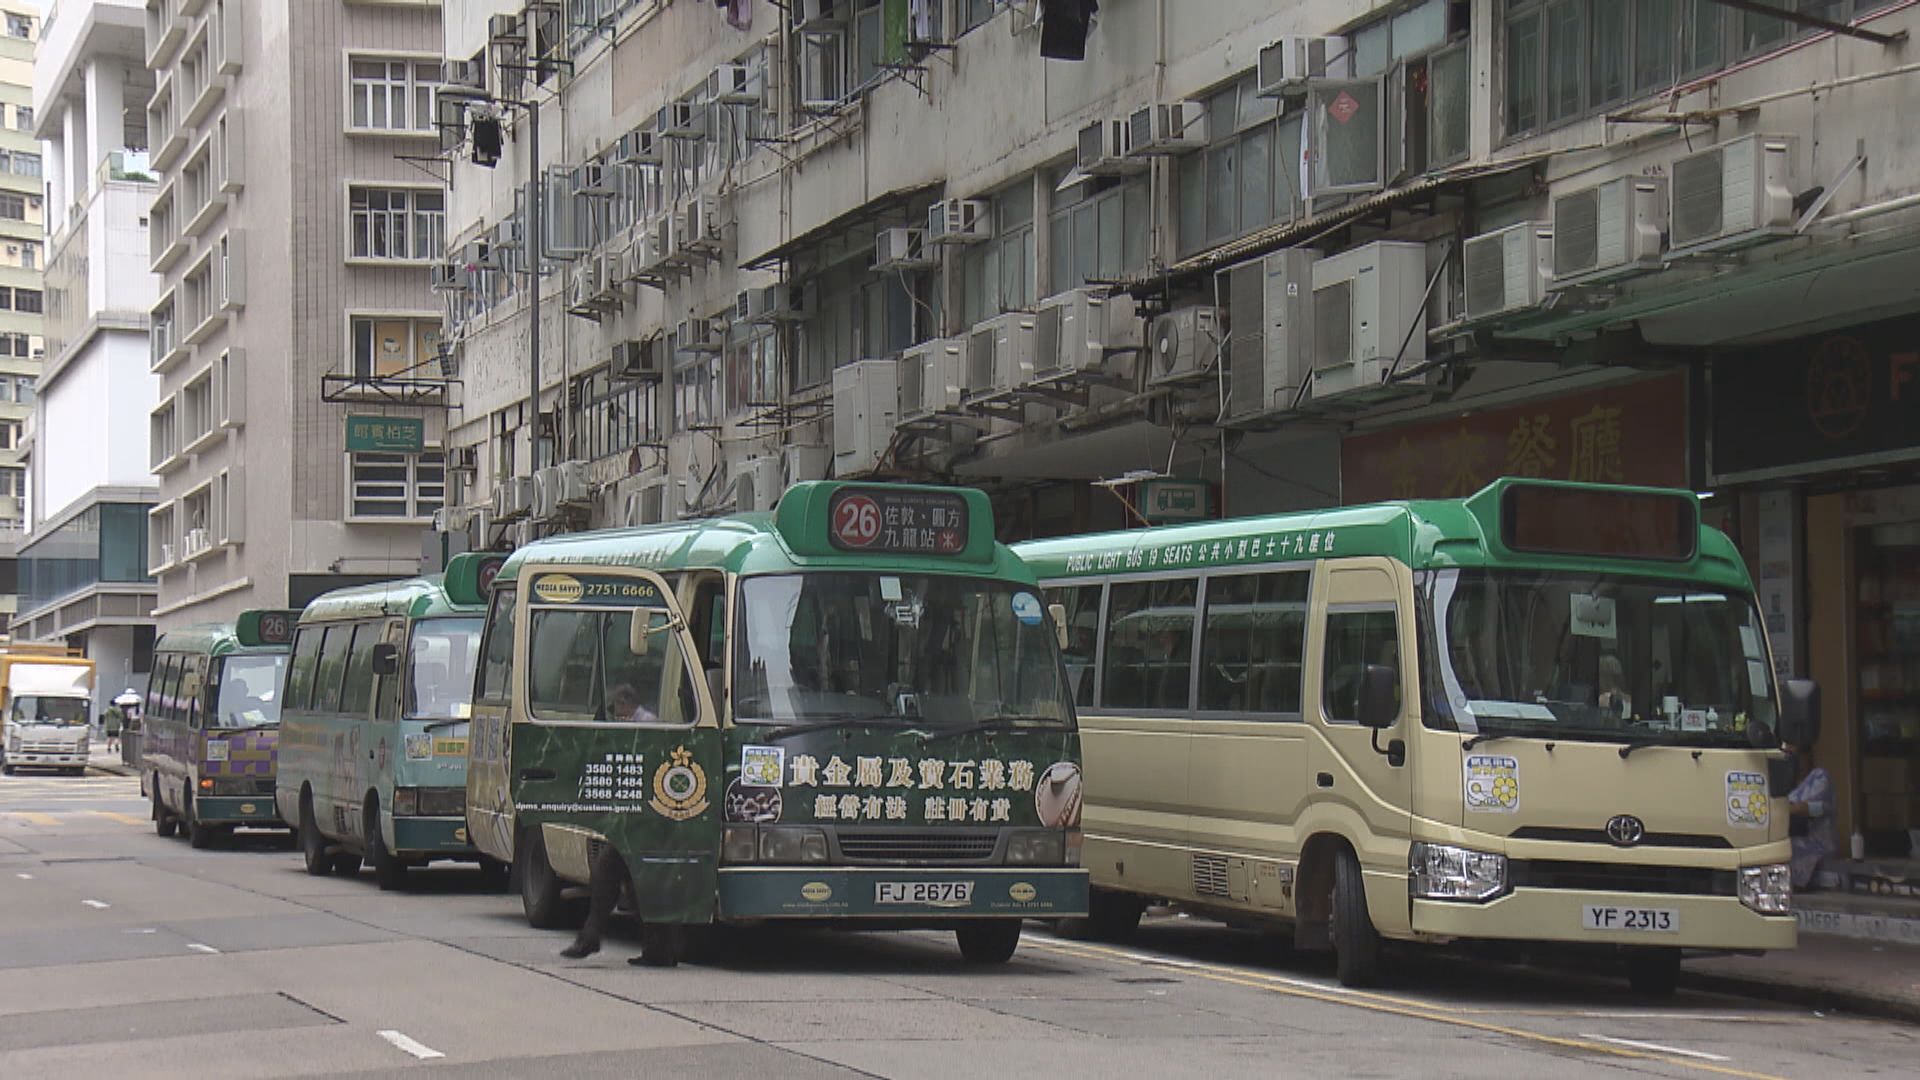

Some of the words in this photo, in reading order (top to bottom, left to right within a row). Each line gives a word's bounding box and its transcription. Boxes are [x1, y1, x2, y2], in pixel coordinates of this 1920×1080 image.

[841, 503, 877, 538] 26
[884, 527, 935, 548] 九龍站
[1198, 531, 1336, 561] 公共小型巴士十九座位
[1065, 553, 1094, 573] PUBLIC
[1097, 551, 1122, 570] LIGHT
[1125, 548, 1144, 568] BUS
[1148, 547, 1158, 566] 19
[1163, 544, 1193, 565] SEATS
[587, 584, 617, 596] 2751
[622, 585, 654, 597] 6666
[265, 618, 284, 636] 26
[617, 764, 643, 775] 1483
[788, 754, 1035, 792] 貴金屬及寶石業務
[616, 777, 643, 788] 1484
[614, 789, 642, 800] 4248
[814, 794, 908, 820] 經營有法
[880, 884, 906, 901] FJ
[914, 884, 967, 900] 2676
[1592, 907, 1617, 927] YF
[1624, 909, 1670, 929] 2313
